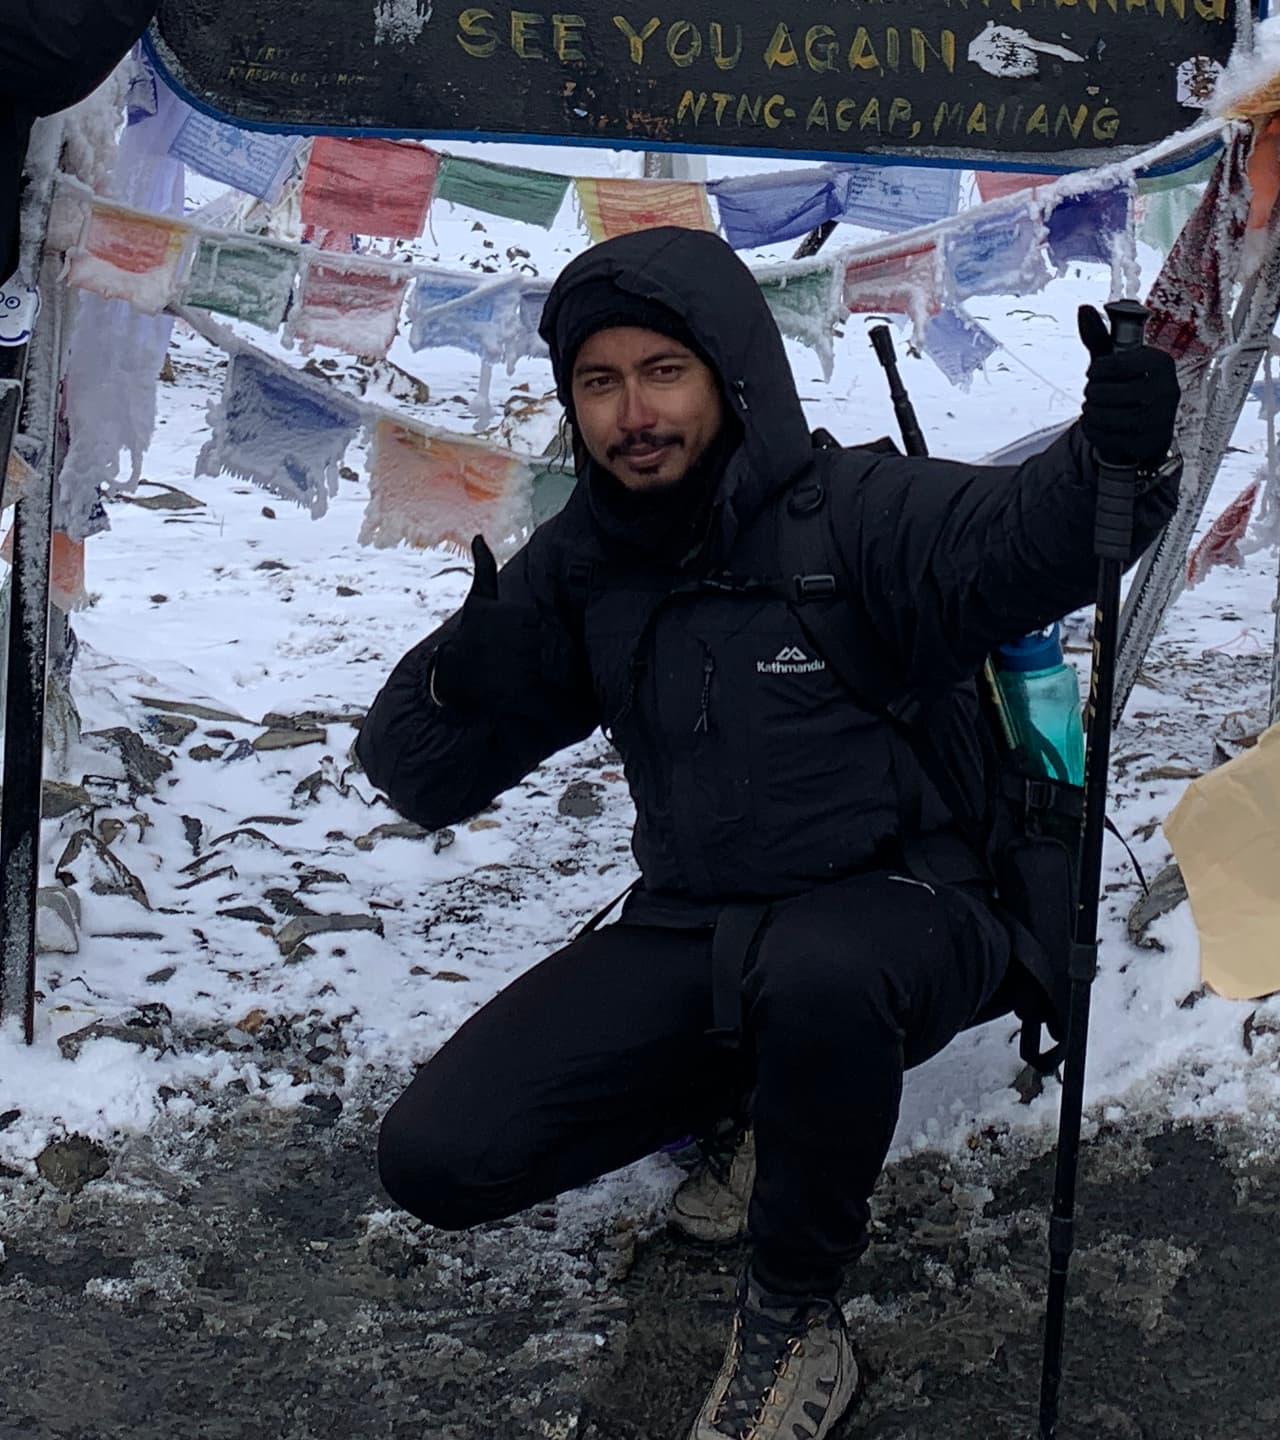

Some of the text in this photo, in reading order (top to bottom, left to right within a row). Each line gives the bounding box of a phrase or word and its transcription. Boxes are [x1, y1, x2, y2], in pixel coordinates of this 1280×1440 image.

[456, 7, 956, 78] SEE YOU AGAIN
[756, 659, 826, 675] Kathmandu
